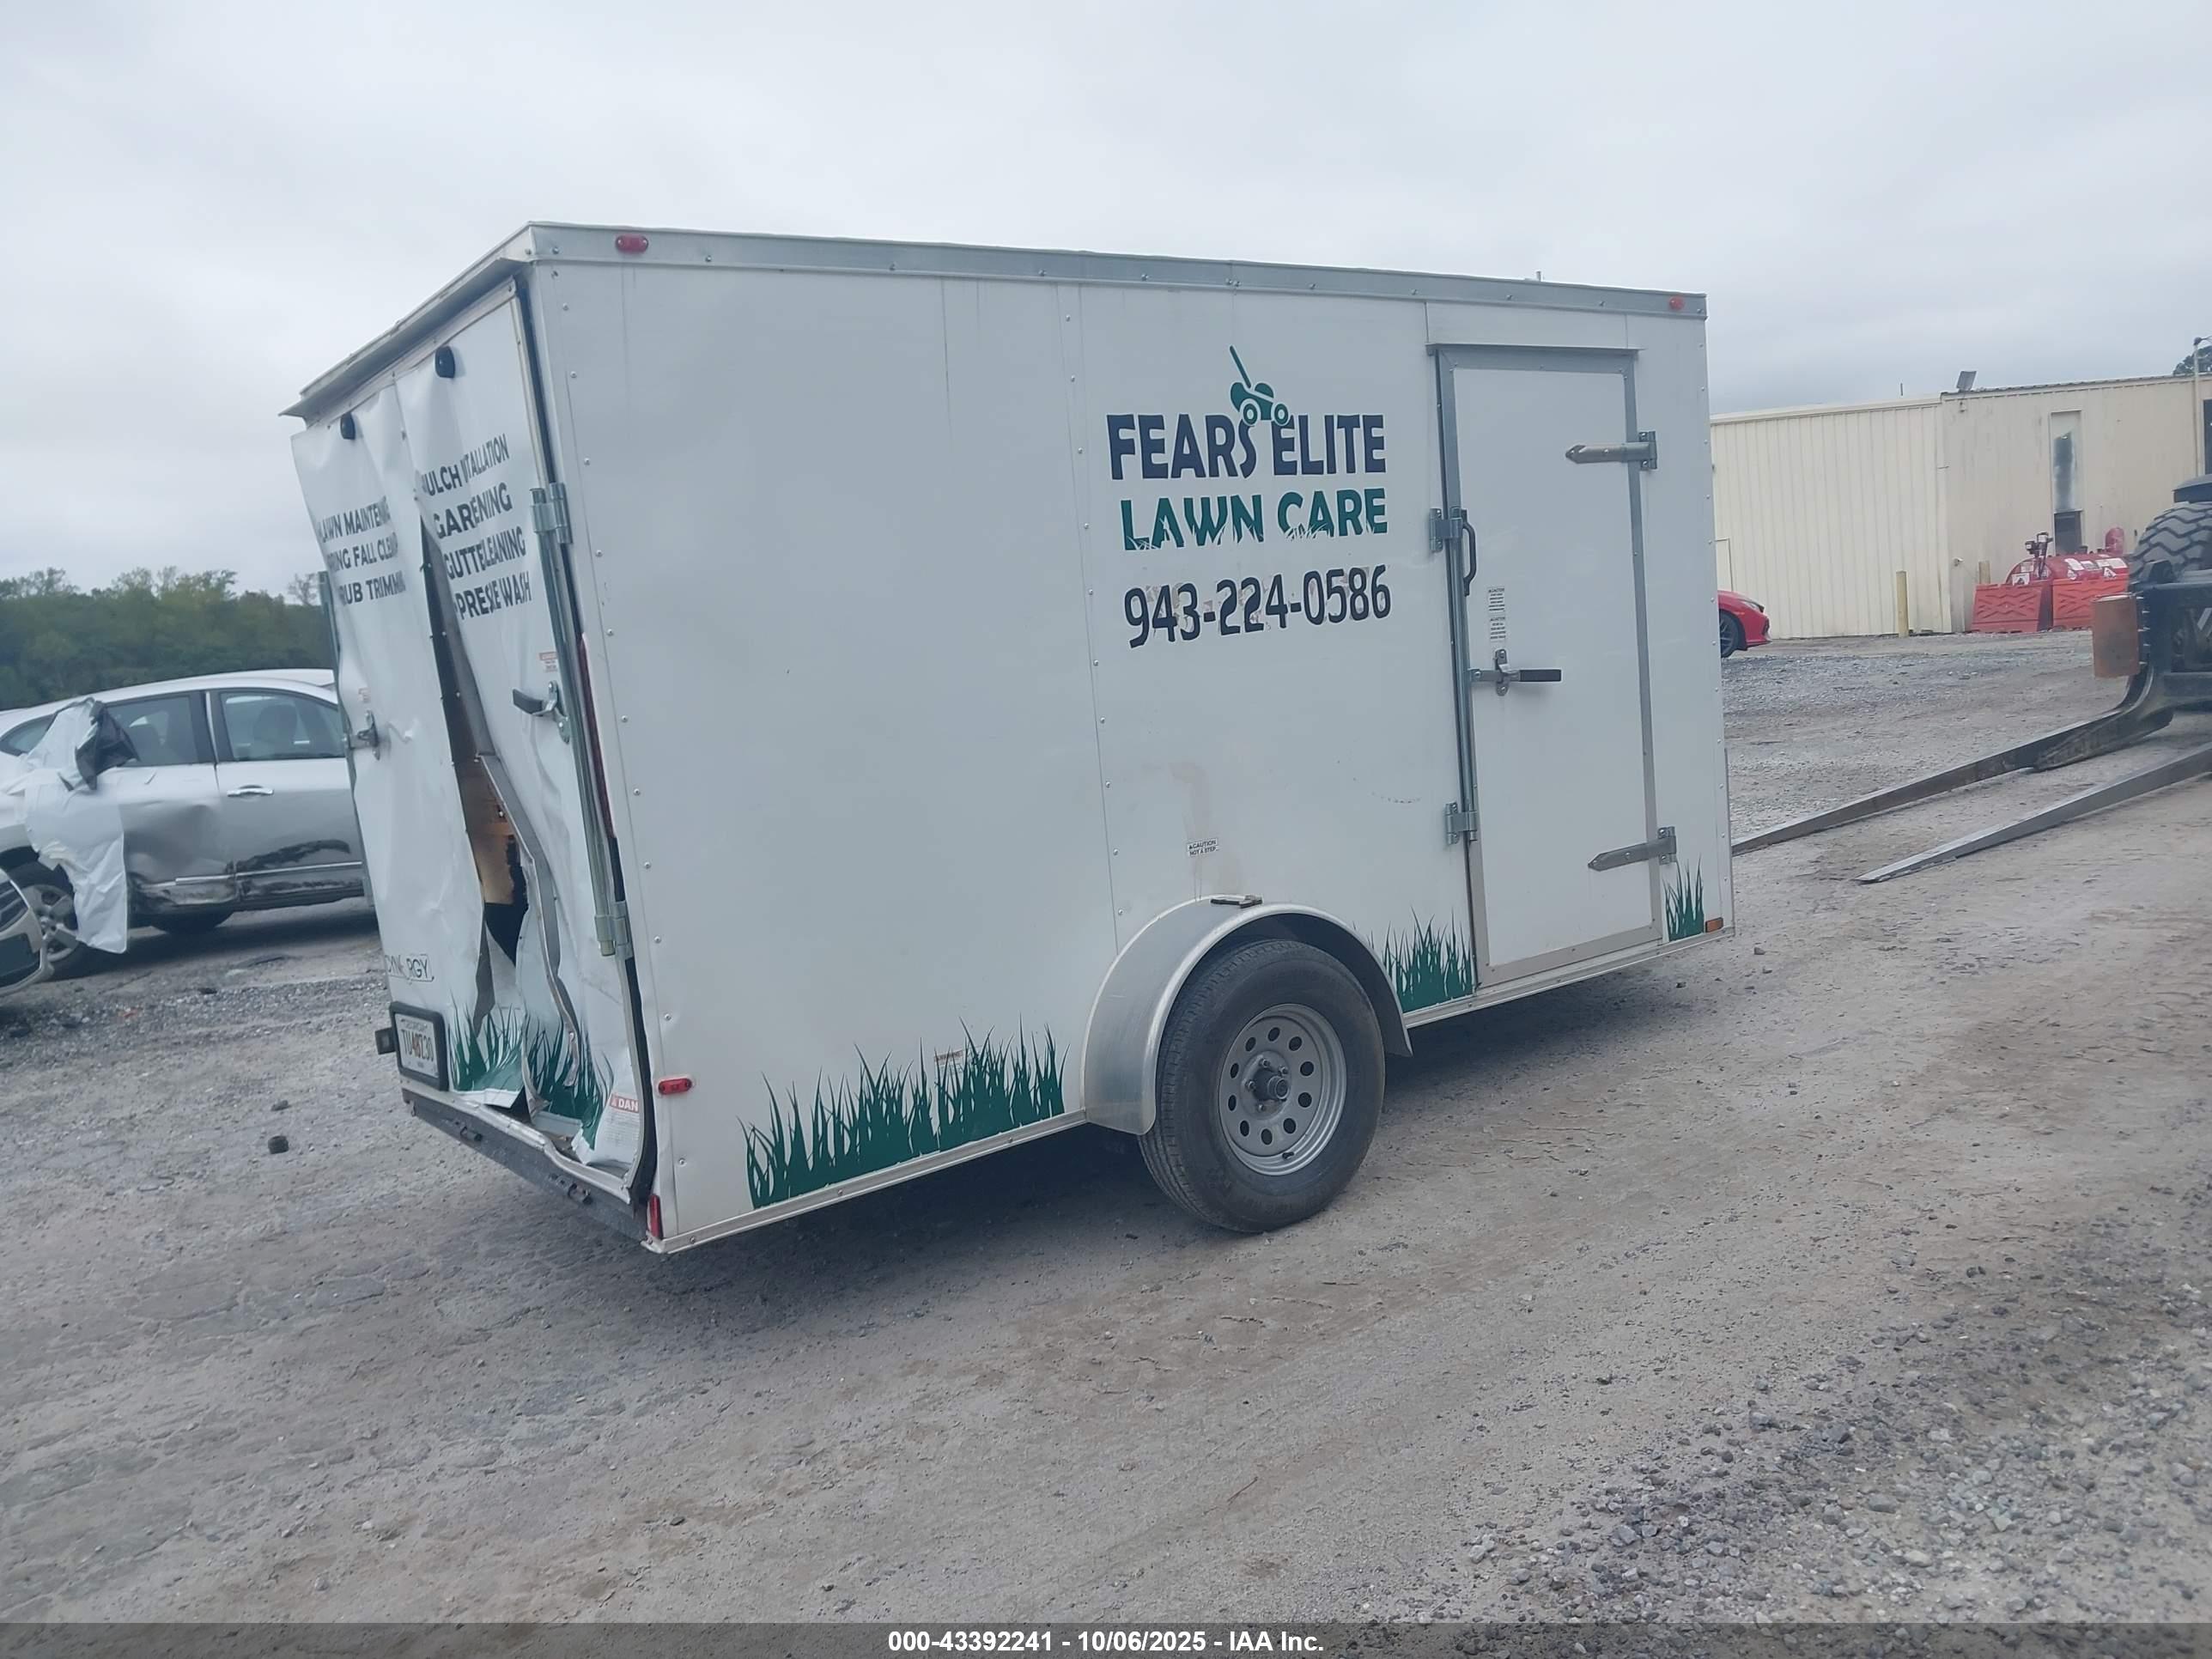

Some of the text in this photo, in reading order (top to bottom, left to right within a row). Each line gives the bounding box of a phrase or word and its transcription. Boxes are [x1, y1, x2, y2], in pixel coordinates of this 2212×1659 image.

[1106, 413, 1387, 480] FEARS ELITE
[422, 465, 462, 496] ULCH
[1120, 487, 1389, 550] LAWN CARE
[1123, 564, 1391, 648] 943-224-0586
